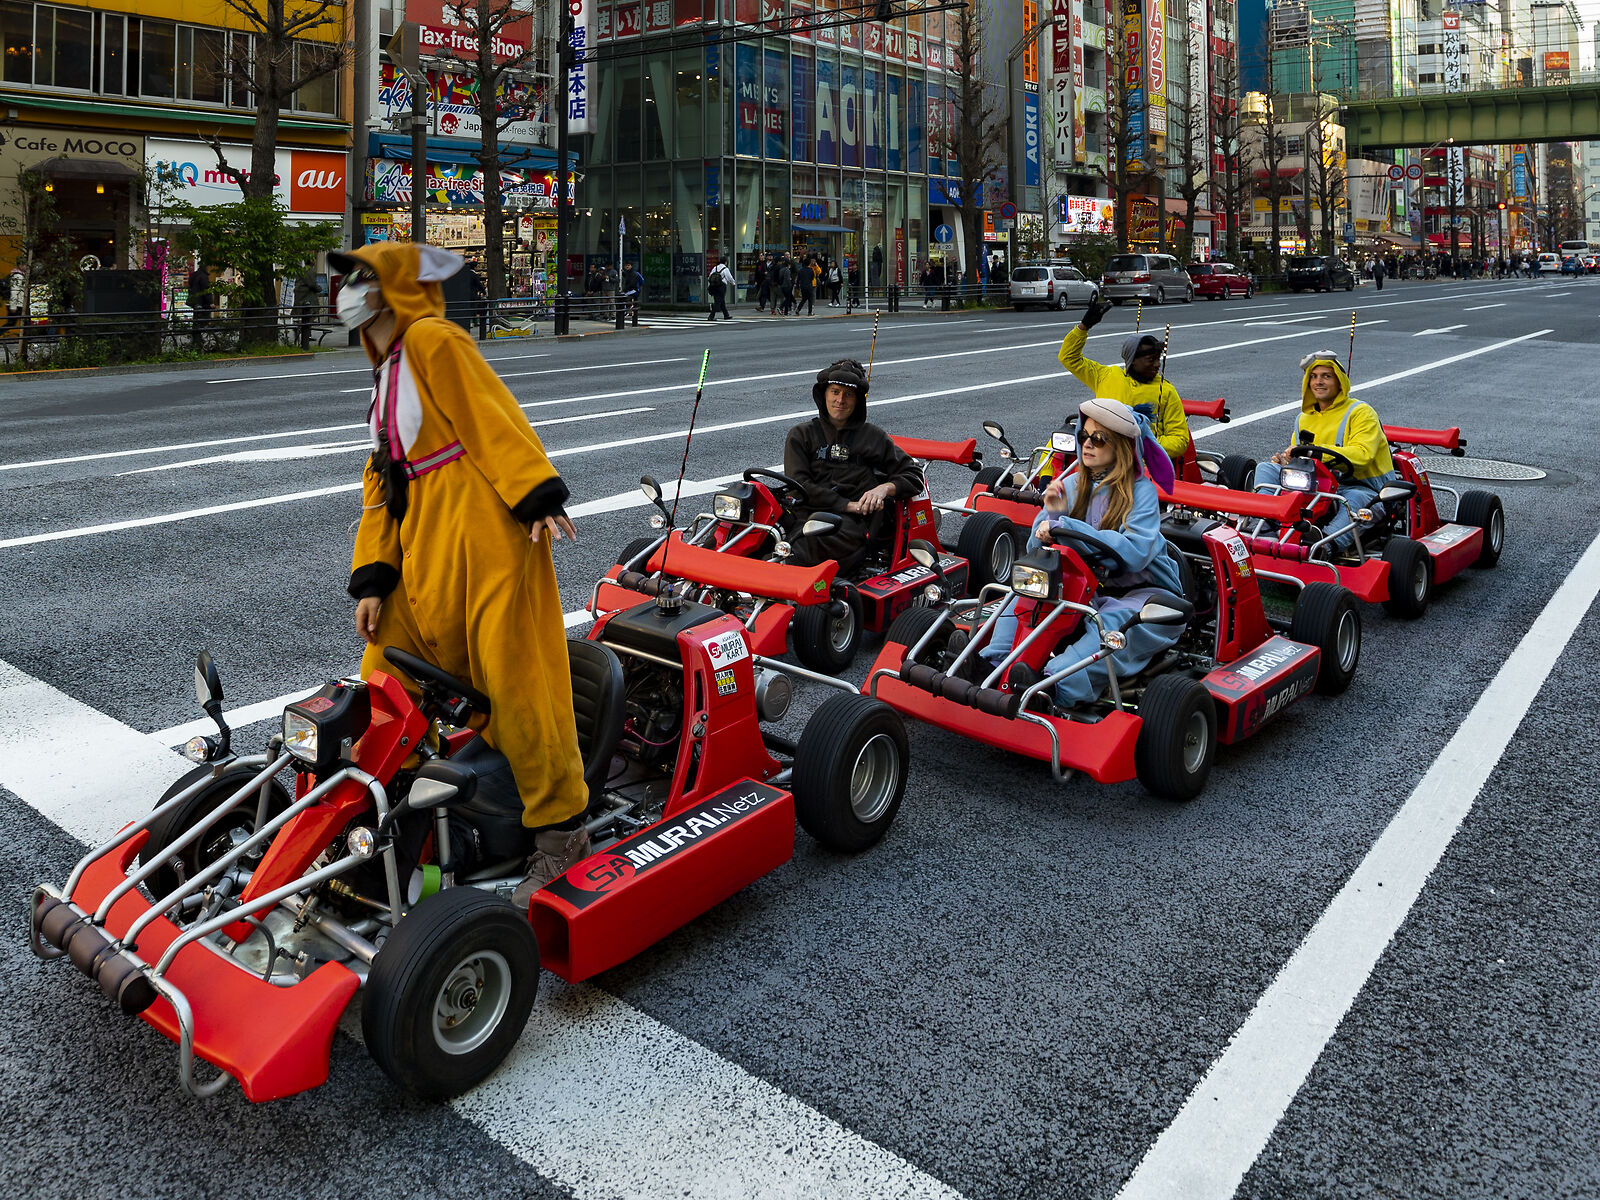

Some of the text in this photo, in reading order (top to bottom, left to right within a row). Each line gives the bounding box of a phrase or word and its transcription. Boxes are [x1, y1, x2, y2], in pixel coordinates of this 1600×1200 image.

[1127, 3, 1138, 14] CD
[1126, 30, 1141, 86] DVD
[1444, 31, 1461, 93] 知的好奇
[741, 80, 779, 104] MEN'S
[744, 106, 783, 131] LADIES
[815, 80, 900, 151] AOKI
[1055, 77, 1069, 156] ダーツバー
[14, 137, 137, 156] Cafe MOCO
[1025, 105, 1039, 165] AOKI
[297, 169, 342, 189] au
[425, 174, 485, 191] Tax-free Sh
[1409, 167, 1420, 178] 50
[800, 202, 826, 220] AOKI
[1345, 223, 1353, 234] P
[896, 243, 904, 282] SALE
[711, 637, 743, 659] SAMURAI
[726, 646, 744, 661] KART
[585, 790, 766, 892] SAMURAI.Netz
